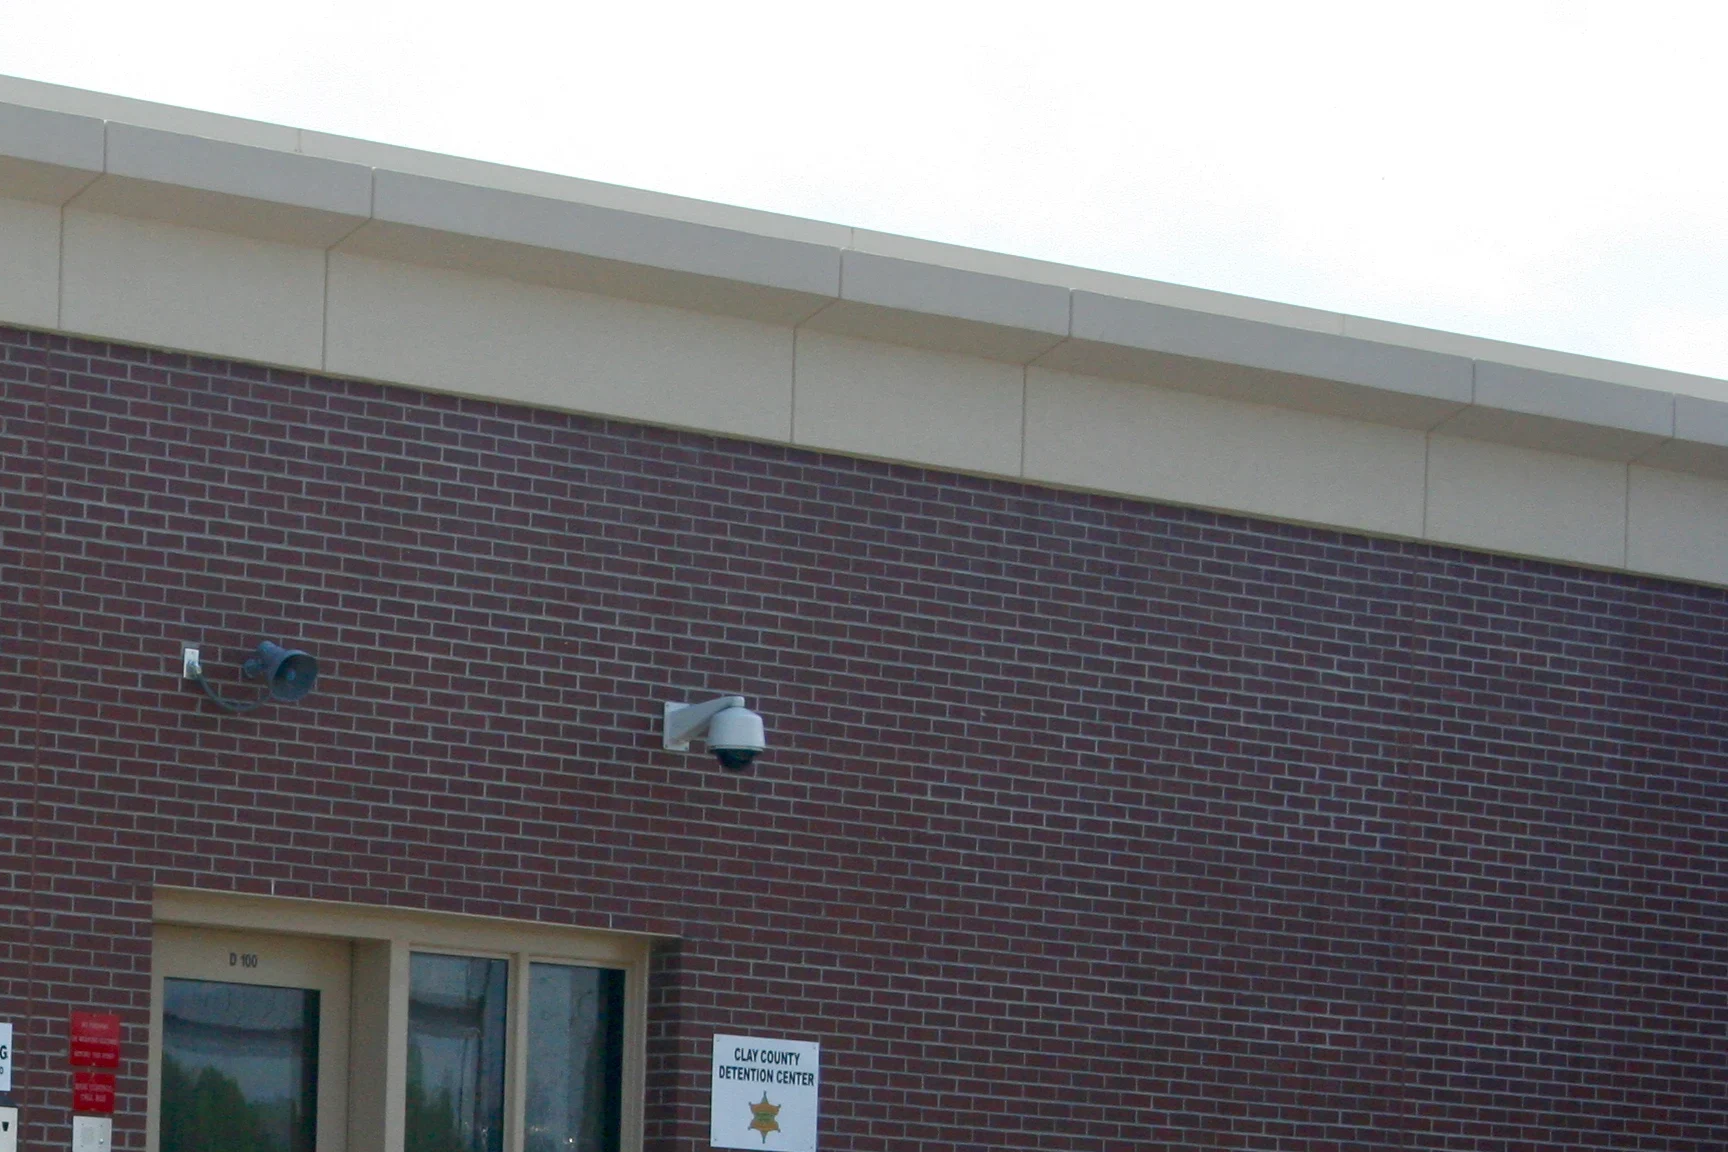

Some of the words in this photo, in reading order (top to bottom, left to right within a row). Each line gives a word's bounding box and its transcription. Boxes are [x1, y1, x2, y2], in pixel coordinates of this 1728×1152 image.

[229, 952, 237, 966] D
[241, 953, 258, 968] 100
[734, 1048, 759, 1062] CLAY
[760, 1050, 801, 1066] COUNTY
[718, 1065, 774, 1083] DETENTION
[776, 1070, 815, 1086] CENTER
